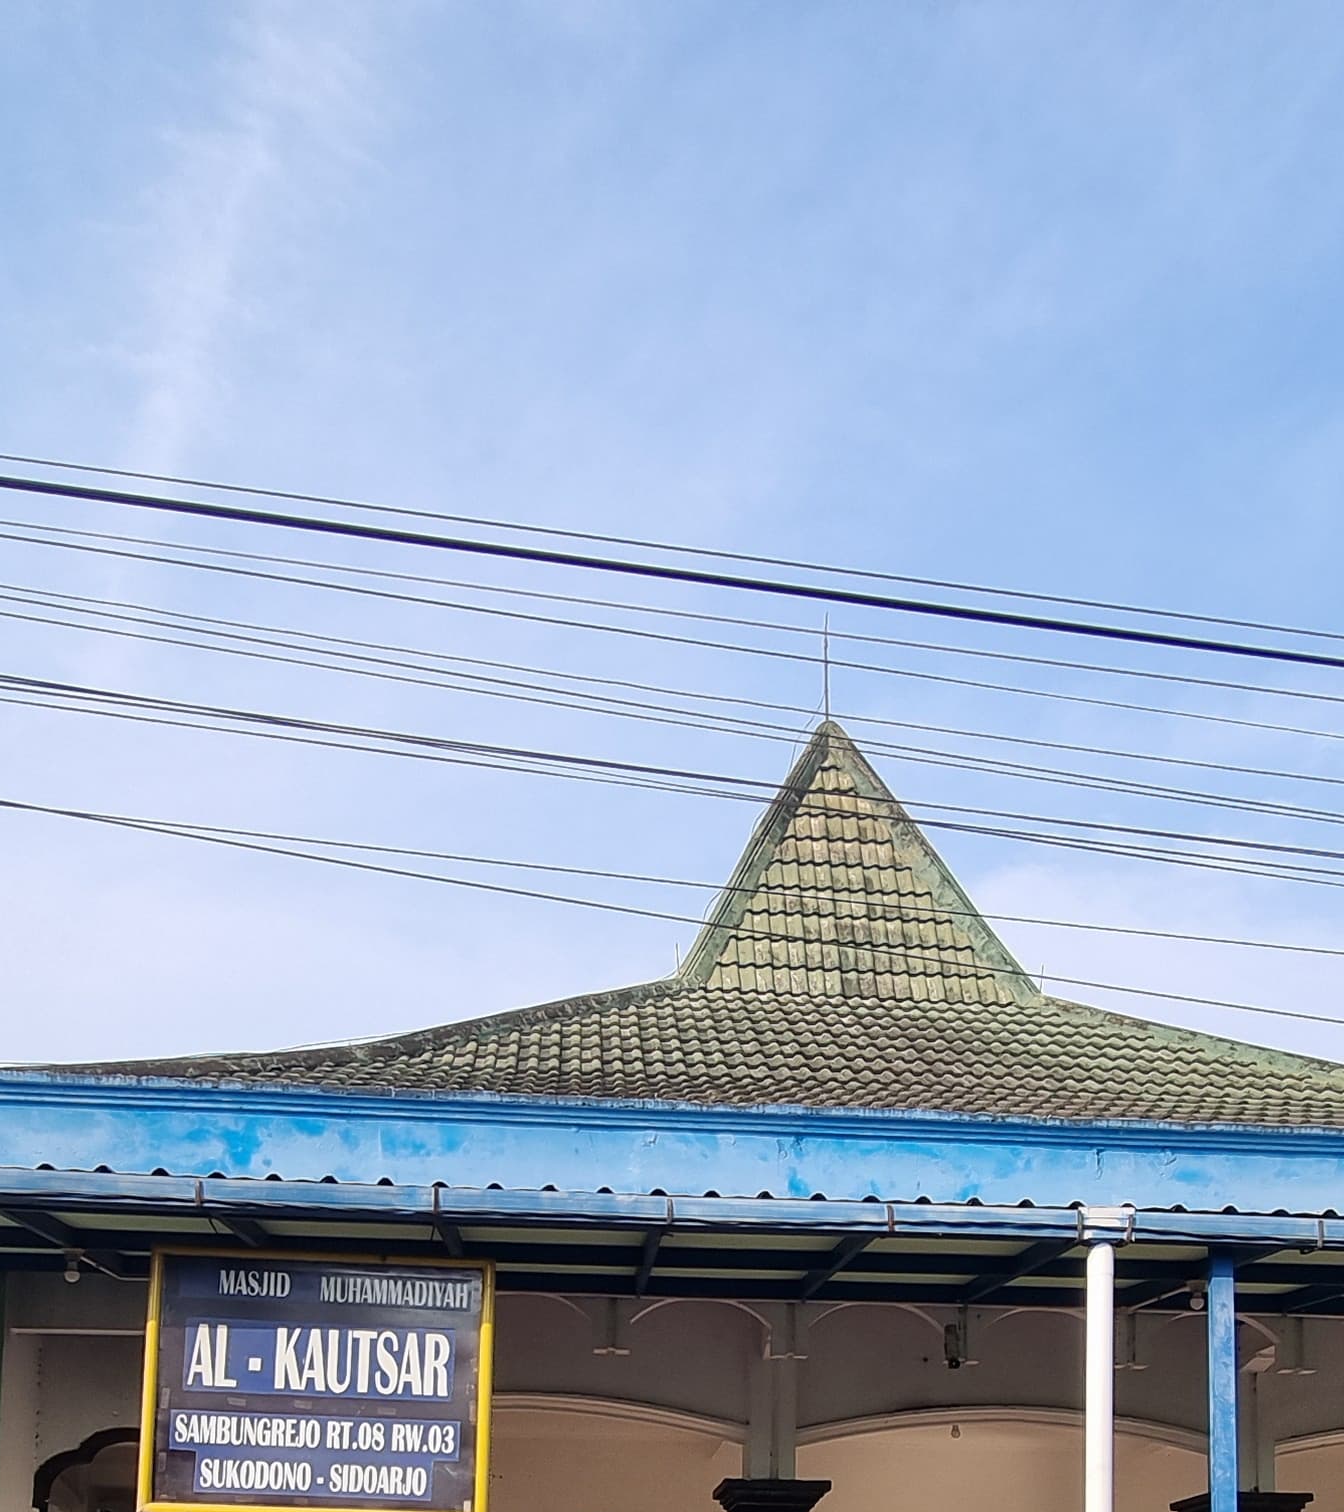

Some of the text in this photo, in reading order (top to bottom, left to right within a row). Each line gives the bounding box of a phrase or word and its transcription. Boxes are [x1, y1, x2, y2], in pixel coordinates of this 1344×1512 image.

[218, 1269, 469, 1309] MASJID MUHAMMADIYAH
[187, 1323, 237, 1388] AL
[273, 1327, 451, 1397] KAUTSAR
[174, 1414, 455, 1454] SAMBUNGREJO RT.08 RW.03
[199, 1459, 312, 1492] SUKODONO
[329, 1464, 427, 1497] SIDOARJO
